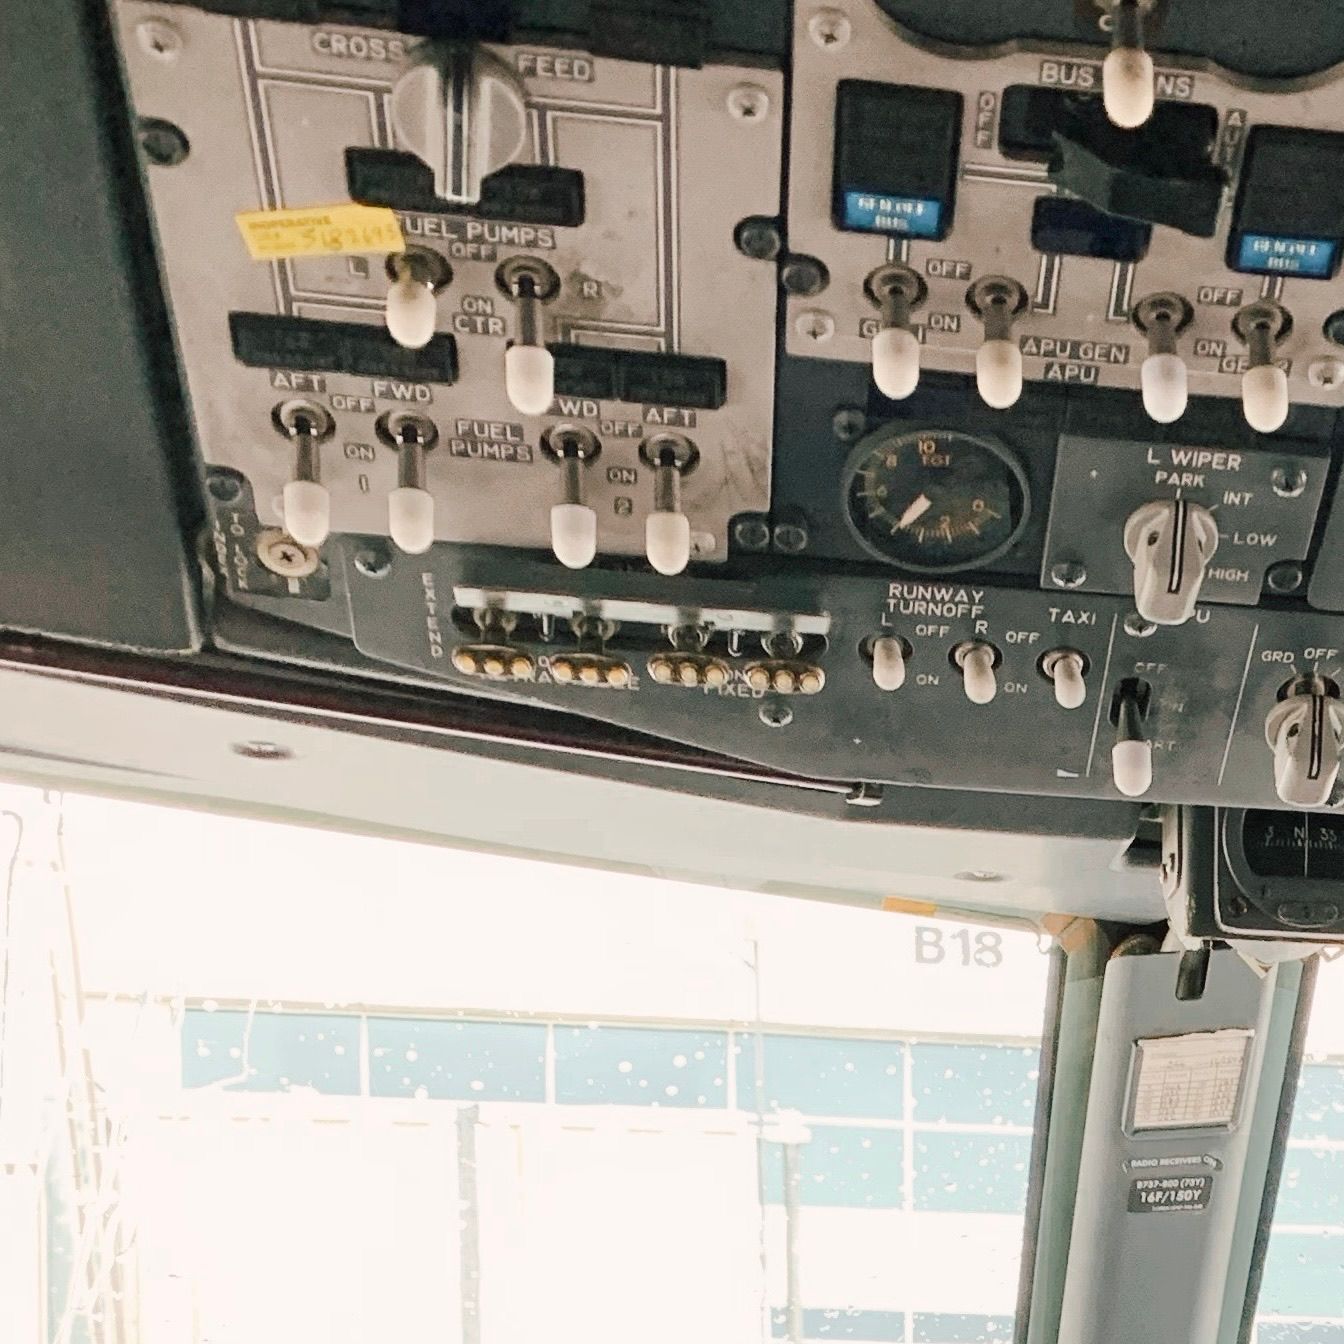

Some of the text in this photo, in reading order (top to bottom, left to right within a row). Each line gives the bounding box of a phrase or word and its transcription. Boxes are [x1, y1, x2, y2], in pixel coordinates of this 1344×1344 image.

[312, 32, 591, 82] CROSS FEED
[1041, 62, 1094, 86] BUS
[466, 221, 554, 248] PUMPS
[927, 261, 969, 278] OFF
[455, 314, 503, 335] CTR
[1024, 338, 1127, 362] APU GEN
[273, 372, 324, 391] AFT
[1047, 365, 1096, 382] APU
[373, 383, 431, 402] FWD
[645, 407, 695, 426] AFT
[456, 420, 522, 441] FUEL
[450, 441, 531, 462] PUMPS
[1148, 449, 1241, 470] L WIPER
[1155, 471, 1204, 487] PARK
[1223, 491, 1252, 505] INT
[1234, 533, 1277, 547] LOW
[889, 584, 983, 602] RUNWAY
[888, 600, 984, 619] TURNOFF
[1049, 608, 1096, 624] TAXI
[914, 926, 1003, 969] B18
